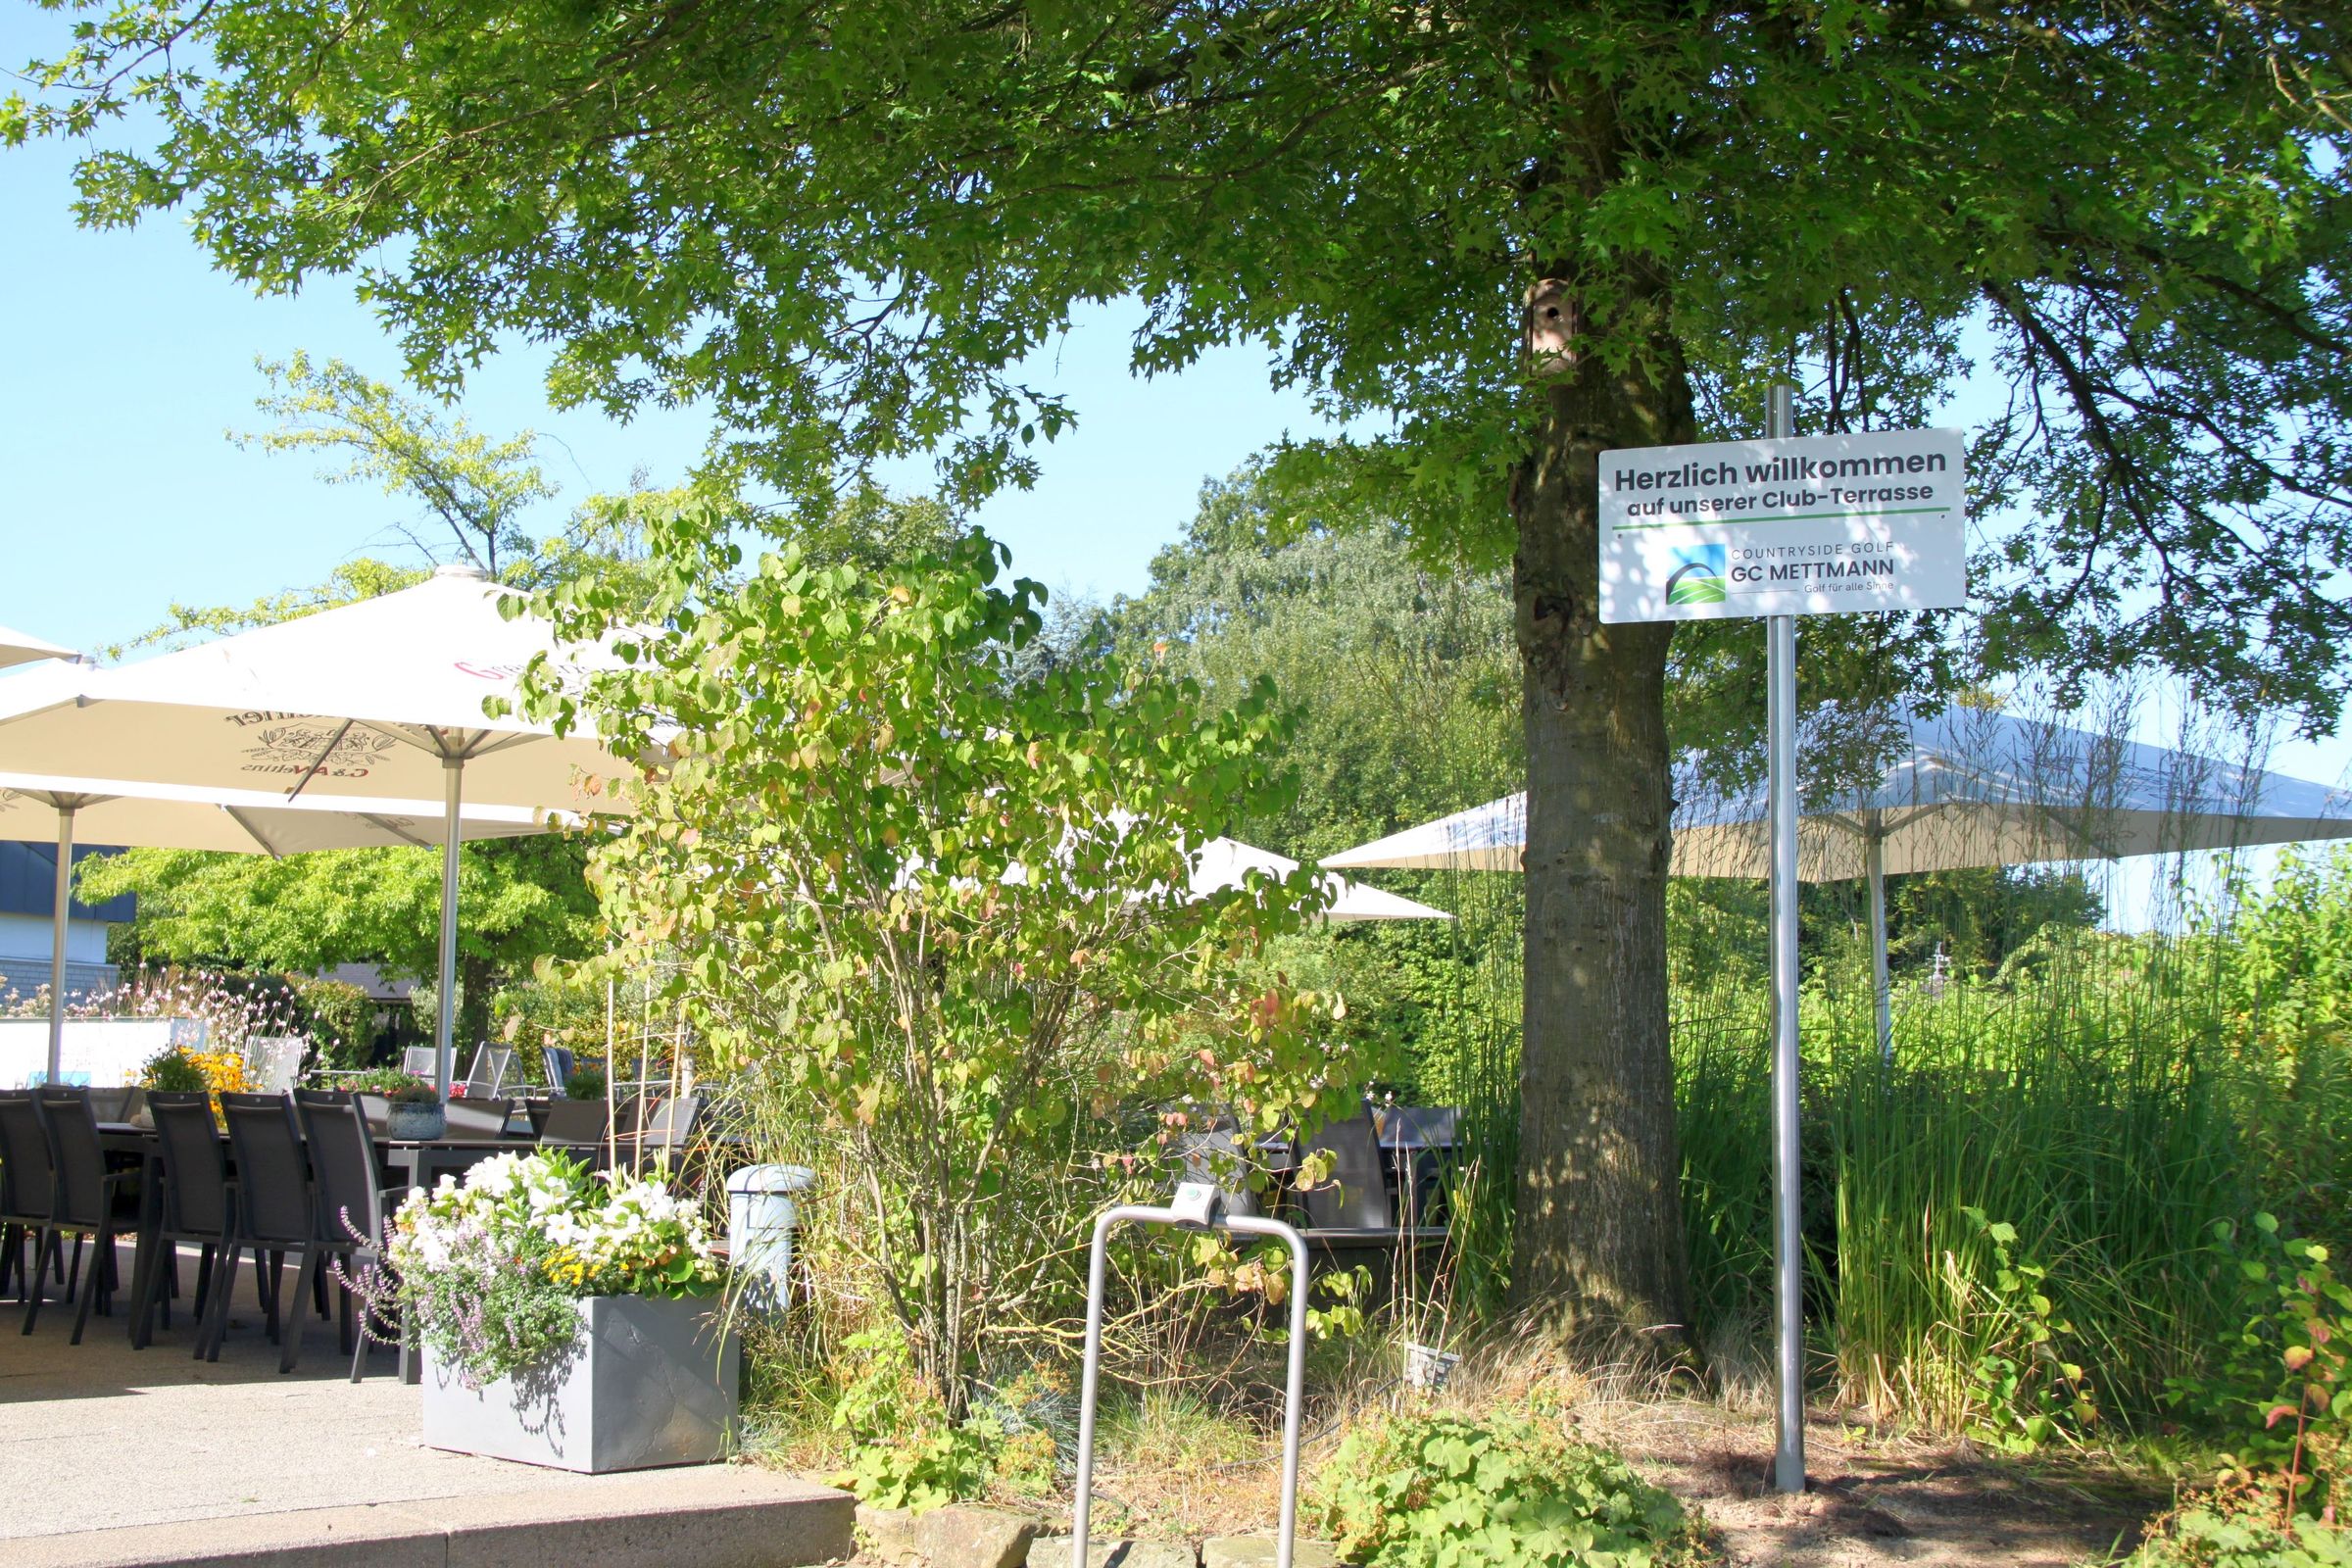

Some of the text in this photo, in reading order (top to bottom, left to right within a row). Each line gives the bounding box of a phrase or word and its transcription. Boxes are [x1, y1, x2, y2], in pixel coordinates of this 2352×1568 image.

[1615, 453, 1946, 491] Herzlich willkommen
[1627, 485, 1934, 516] auf unserer Club-Terrasse
[1731, 541, 1893, 561] COUNTRYSIDE GOLF
[1731, 559, 1894, 581] GC METTMANN
[1804, 584, 1825, 594] Golf
[1828, 582, 1842, 592] für
[1845, 581, 1863, 592] alle
